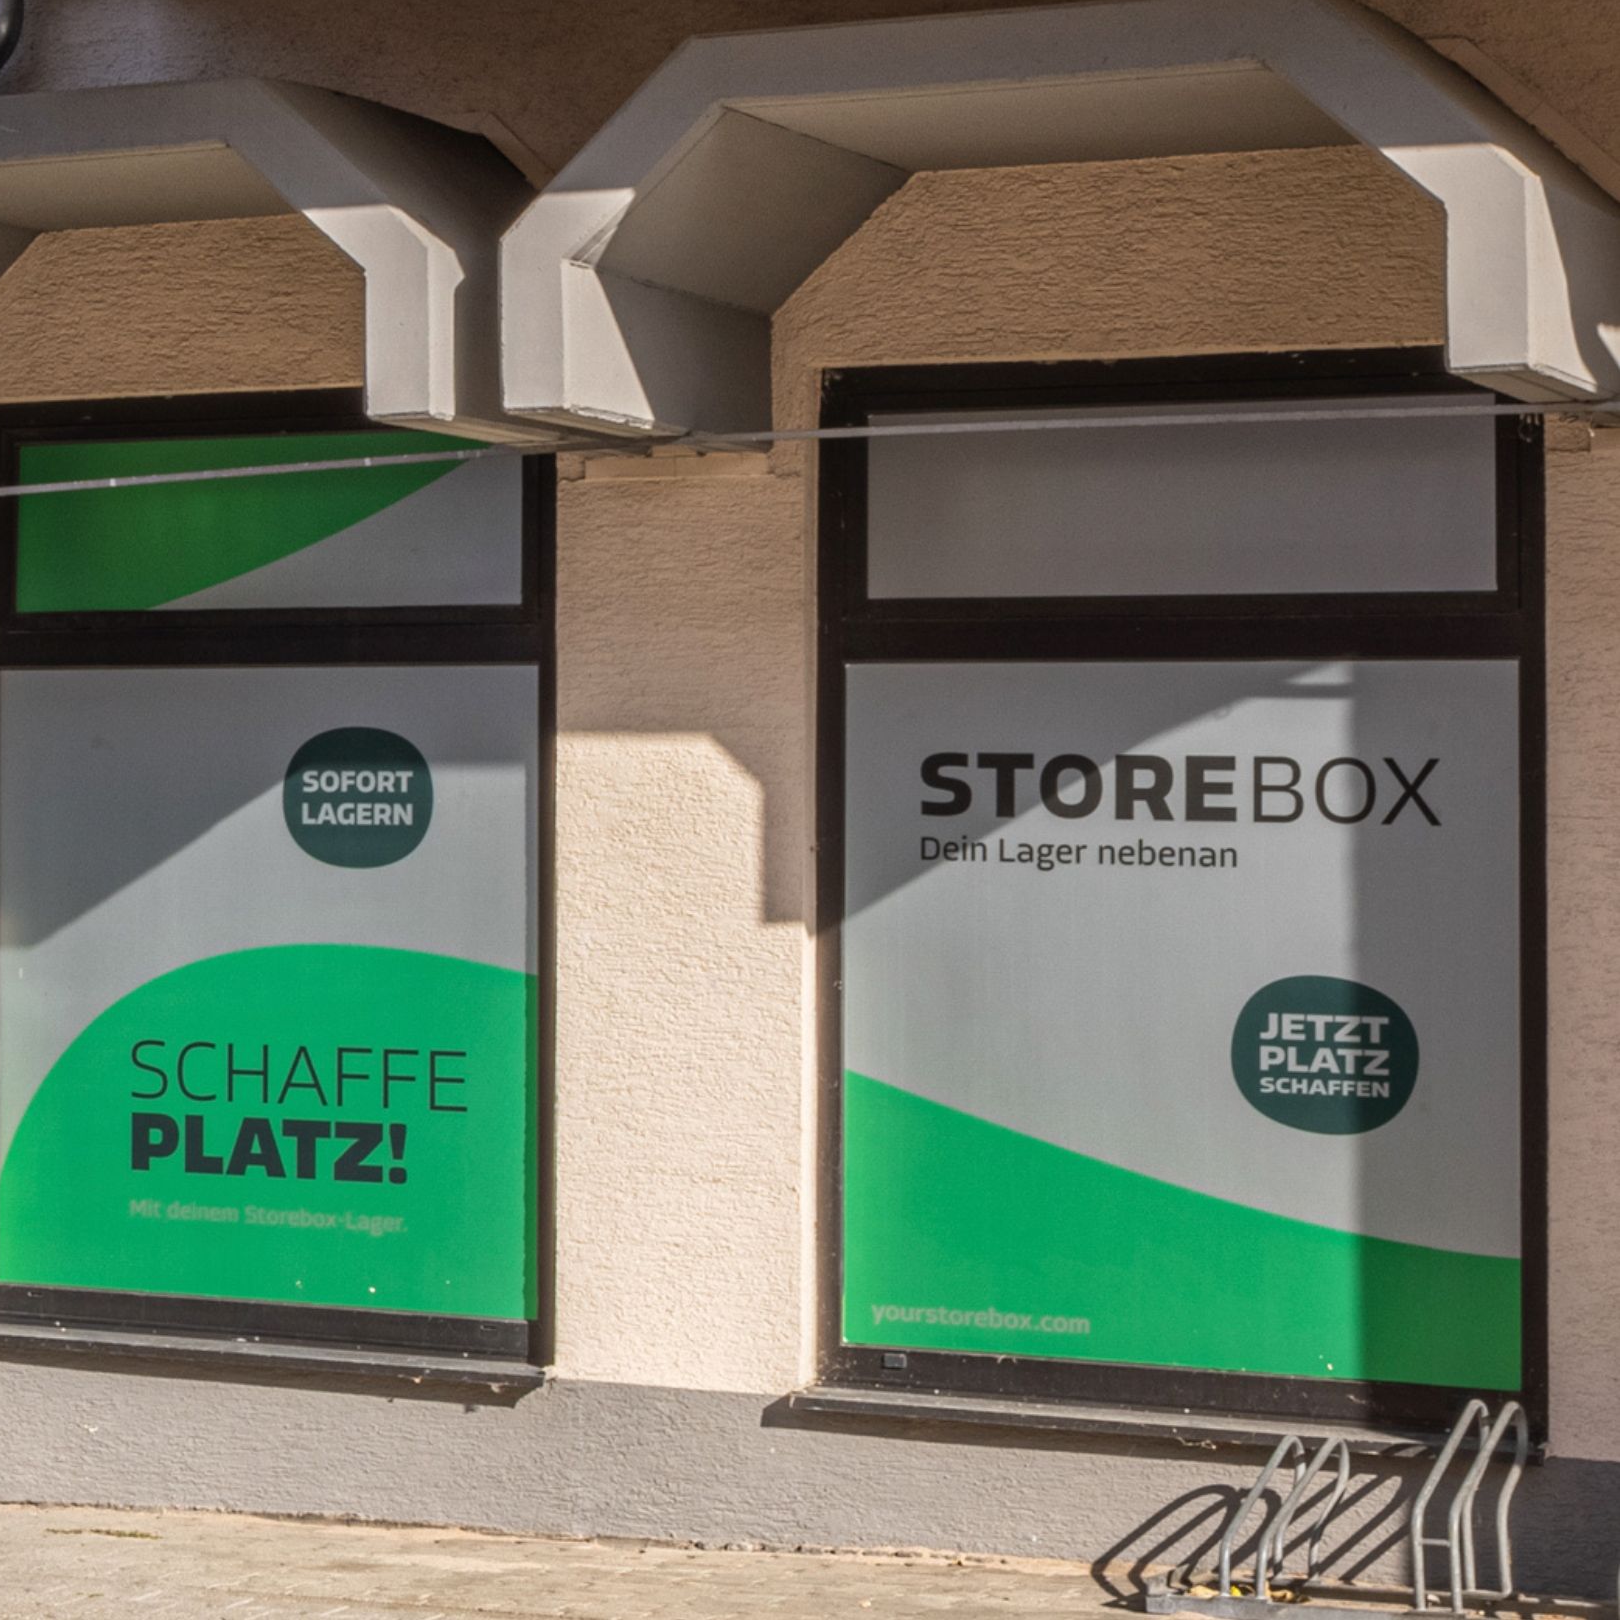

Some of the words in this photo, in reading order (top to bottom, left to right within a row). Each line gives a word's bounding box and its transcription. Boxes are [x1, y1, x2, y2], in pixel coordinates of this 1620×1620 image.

[302, 770, 414, 793] SOFORT
[920, 752, 1442, 826] STOREBOX
[302, 802, 414, 826] LAGERN
[920, 836, 988, 863] Dein
[998, 837, 1089, 871] Lager
[1098, 840, 1239, 869] nebenan
[1260, 1012, 1390, 1044] JETZT
[130, 1039, 469, 1113] SCHAFFE
[1260, 1045, 1390, 1077] PLATZ
[1259, 1077, 1391, 1098] SCHAFFEN
[131, 1111, 408, 1186] PLATZ!
[129, 1199, 161, 1219] Mit
[166, 1201, 239, 1223] deinem
[244, 1205, 408, 1237] Storebox-Lager.
[871, 1303, 1090, 1335] yourstorebox.com
